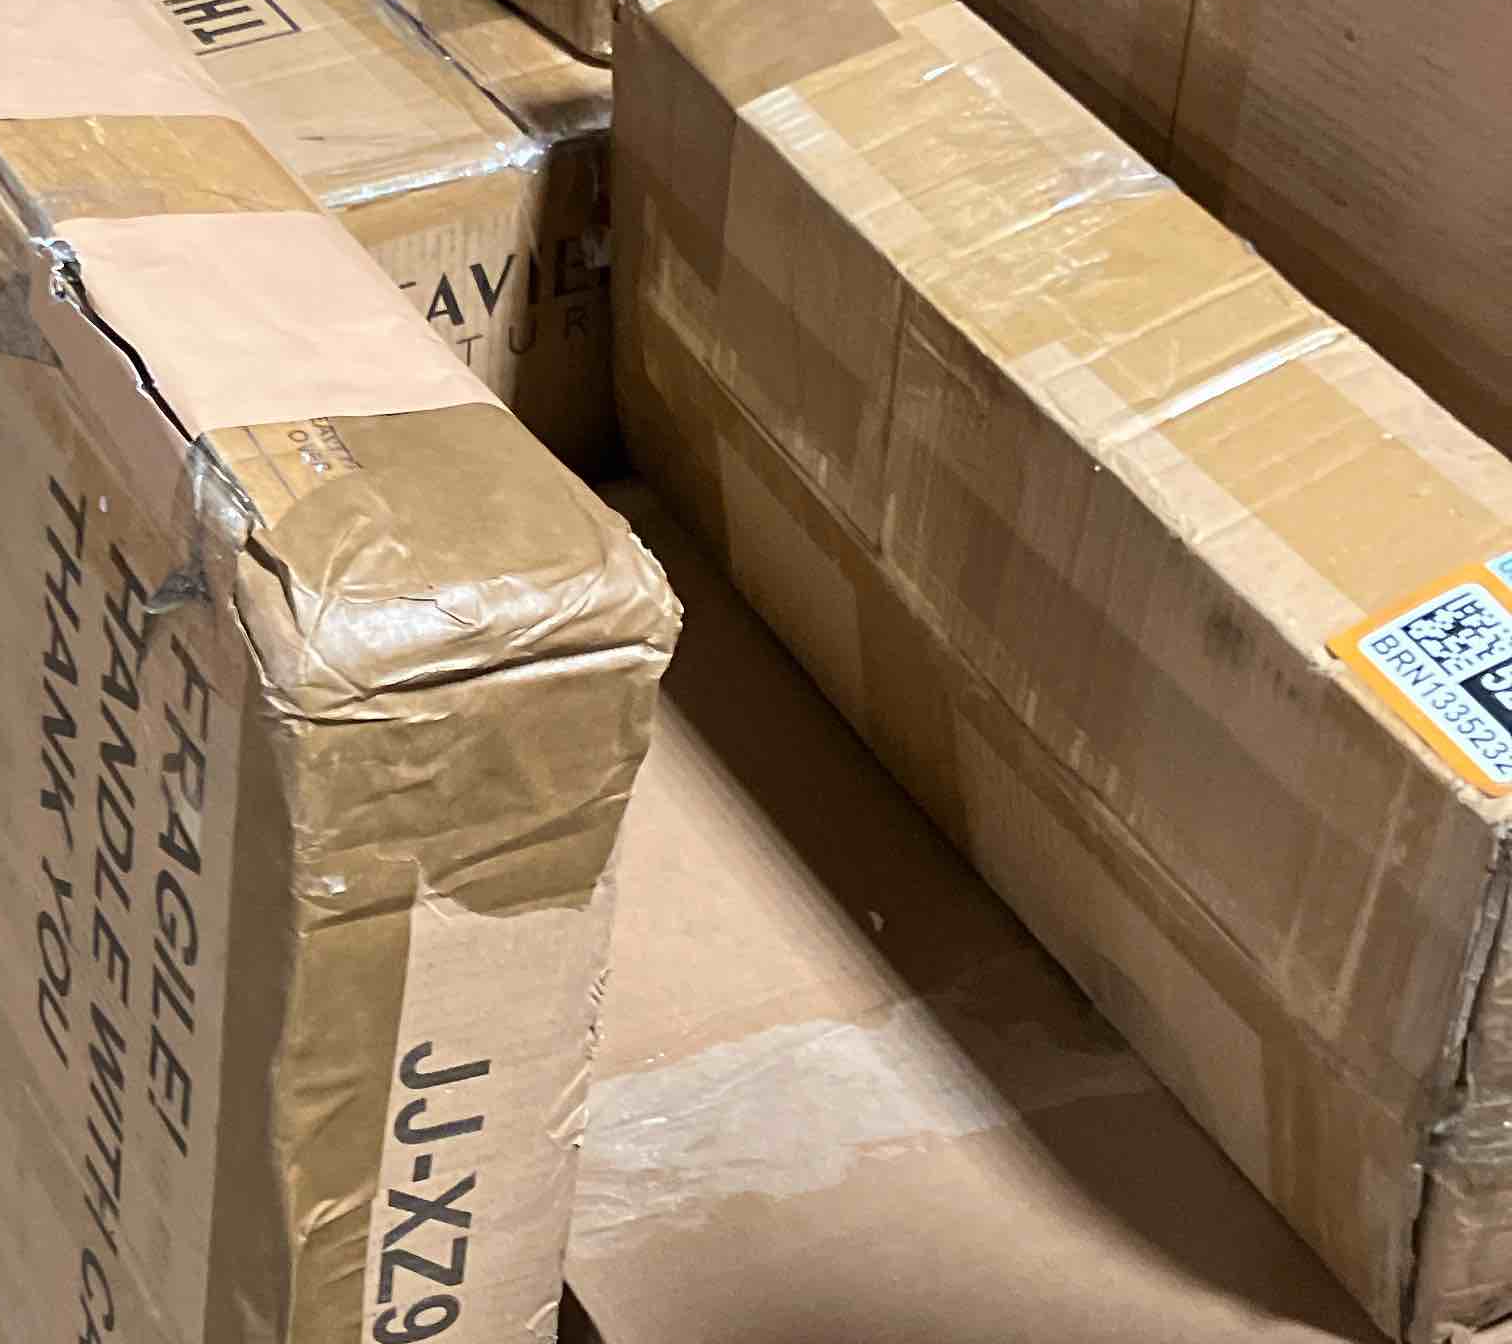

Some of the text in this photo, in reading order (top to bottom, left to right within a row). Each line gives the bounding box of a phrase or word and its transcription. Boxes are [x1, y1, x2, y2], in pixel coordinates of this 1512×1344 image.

[36, 474, 87, 1071] THANK YOU
[92, 542, 149, 1009] HANDLE
[147, 632, 212, 1158] FRAGILE!
[84, 1000, 127, 1257] WITH
